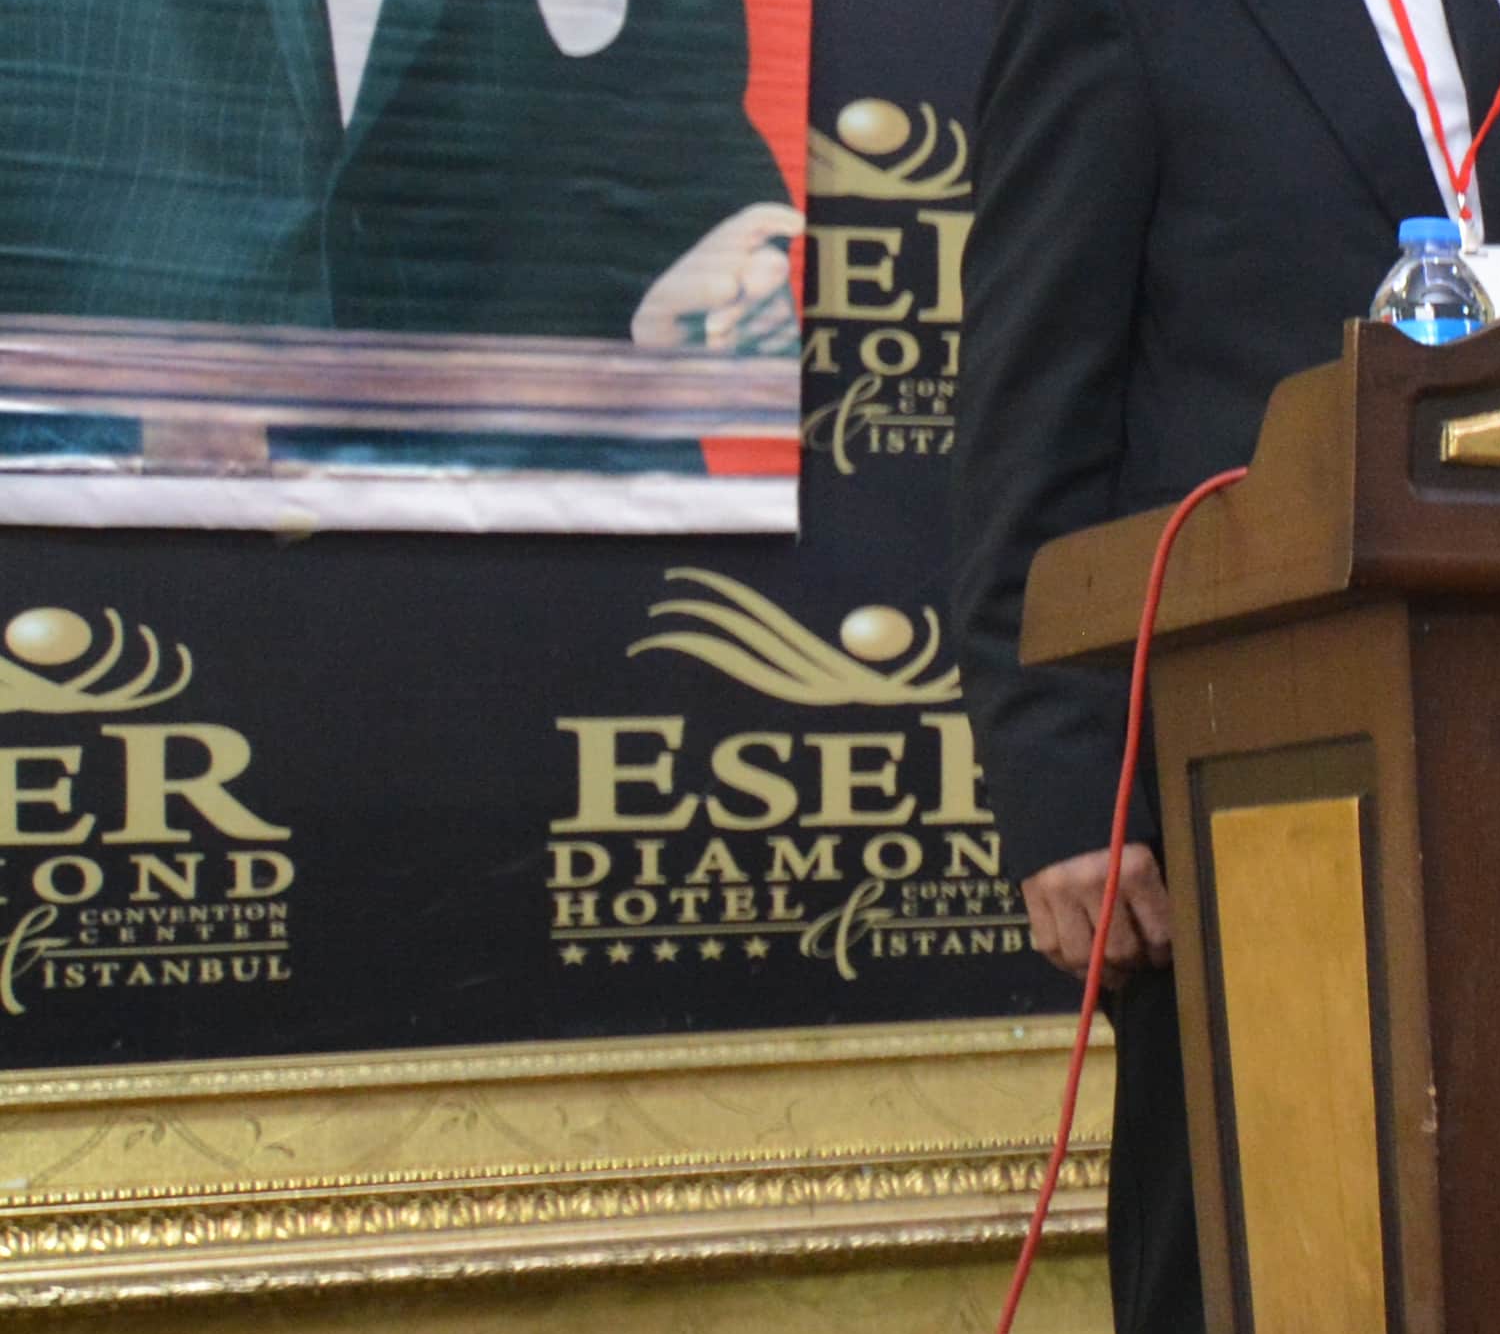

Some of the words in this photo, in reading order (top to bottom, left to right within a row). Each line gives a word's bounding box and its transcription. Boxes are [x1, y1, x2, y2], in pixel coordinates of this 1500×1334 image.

[0, 723, 292, 846] ER
[546, 830, 1001, 888] DIAMON
[78, 901, 289, 927] CONVENTION
[552, 886, 805, 927] HOTEL
[902, 880, 1012, 903] CONVEN
[902, 898, 1014, 917] CENT
[78, 919, 288, 946] CENTER
[871, 927, 1036, 958] ISTANB
